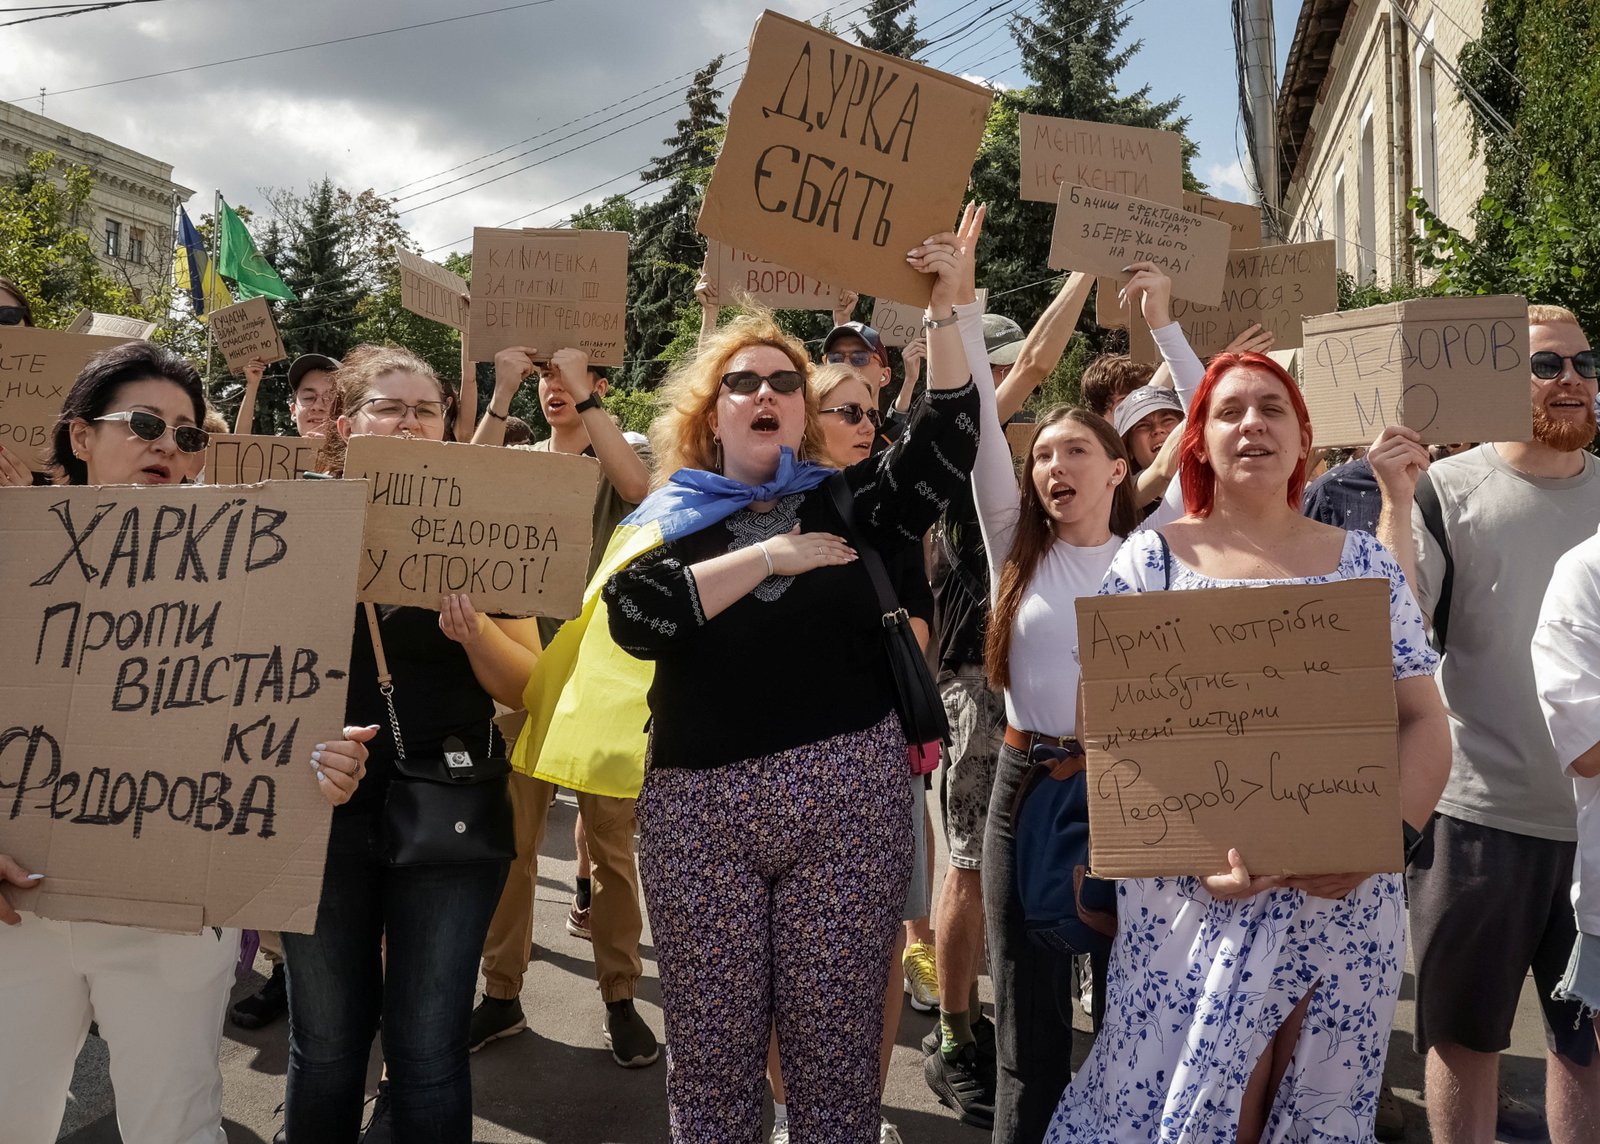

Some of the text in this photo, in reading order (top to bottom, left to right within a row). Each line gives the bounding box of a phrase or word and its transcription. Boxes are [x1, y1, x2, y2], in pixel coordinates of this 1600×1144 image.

[762, 41, 920, 162] ДУРКА
[1112, 135, 1153, 163] НАМ
[754, 144, 894, 247] ЄБАТЬ
[1081, 222, 1153, 246] ЗБЕРЕЖИ
[1108, 246, 1125, 257] НА
[484, 272, 506, 296] ЗА
[213, 308, 249, 330] СУЧАСНА
[554, 306, 619, 331] ФЕДОРОВА
[221, 330, 260, 349] СУЧАСНОГО
[260, 339, 272, 350] МО
[1316, 319, 1521, 388] ФЕДОРОВ
[214, 441, 325, 485] ПОВЕ
[362, 464, 463, 507] ИШІТЬ
[410, 515, 559, 551] ФЕДОРОВА
[361, 549, 551, 594] У СПОКОЇ!
[1091, 598, 1351, 669] Армії потрібне
[1262, 665, 1285, 680] а
[1303, 660, 1341, 675] не
[1189, 706, 1280, 736] штурми
